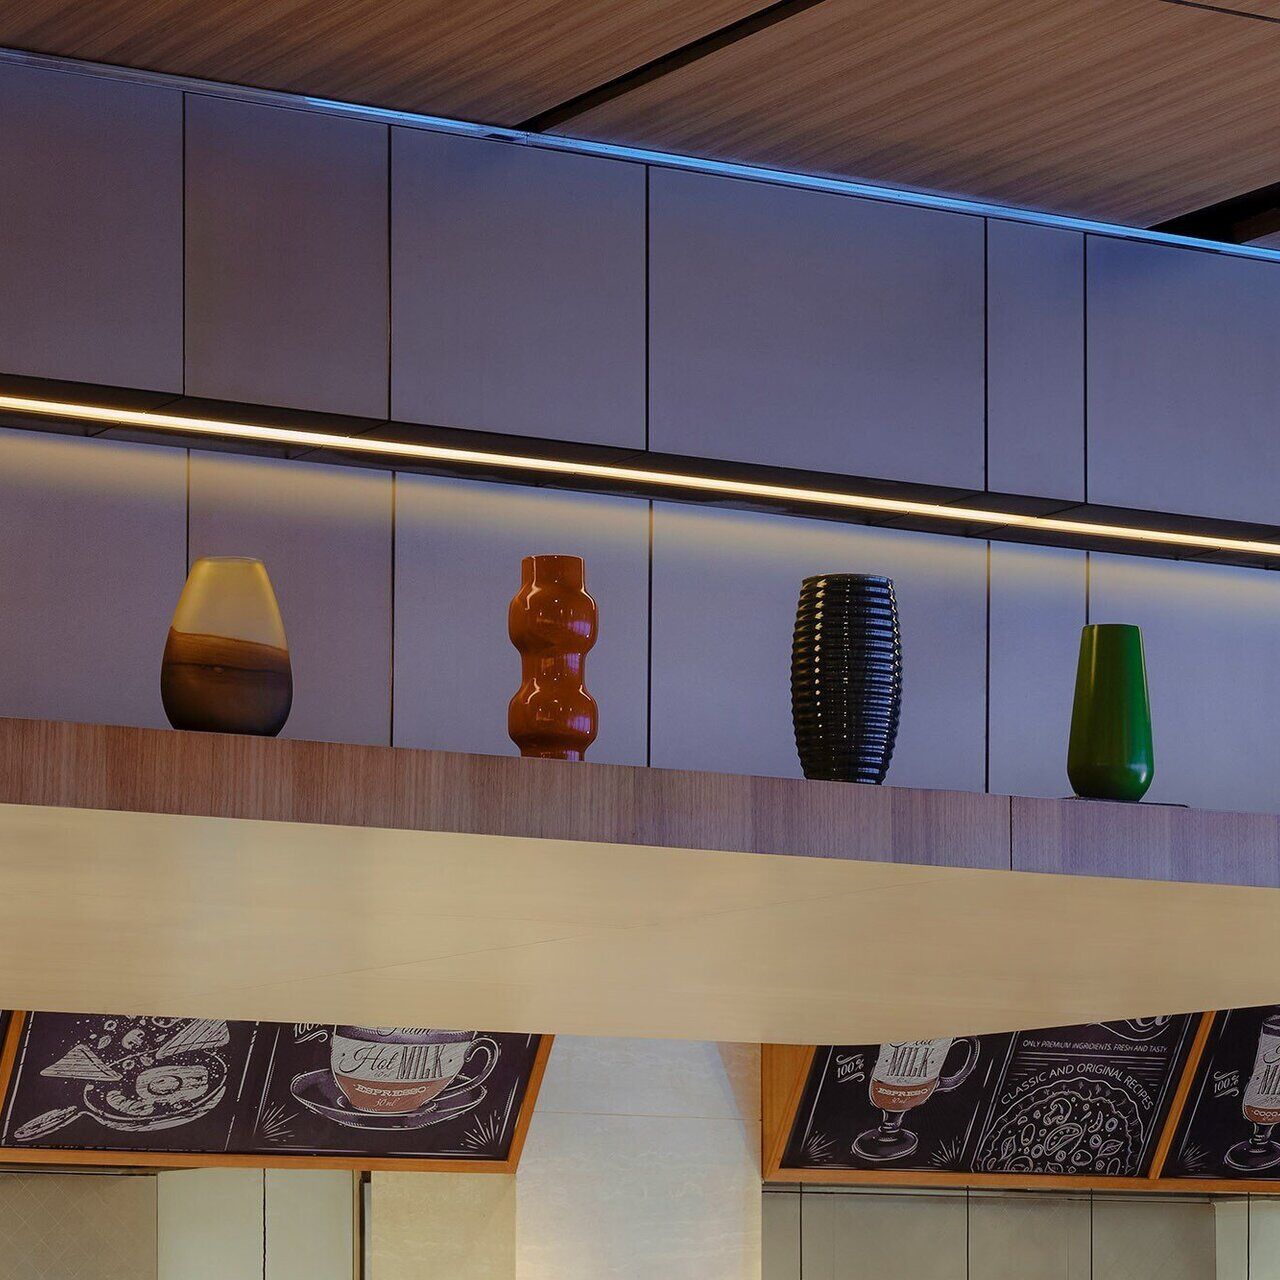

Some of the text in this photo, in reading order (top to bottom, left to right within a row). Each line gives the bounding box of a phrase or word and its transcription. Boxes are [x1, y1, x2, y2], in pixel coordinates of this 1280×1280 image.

[338, 1045, 447, 1080] Hot MILK
[837, 1058, 864, 1079] 100%
[886, 1046, 935, 1078] MILK
[355, 1084, 428, 1097] ESPRESSO
[1001, 1062, 1154, 1111] CLASSIC AND ORIGINAL RECIPES
